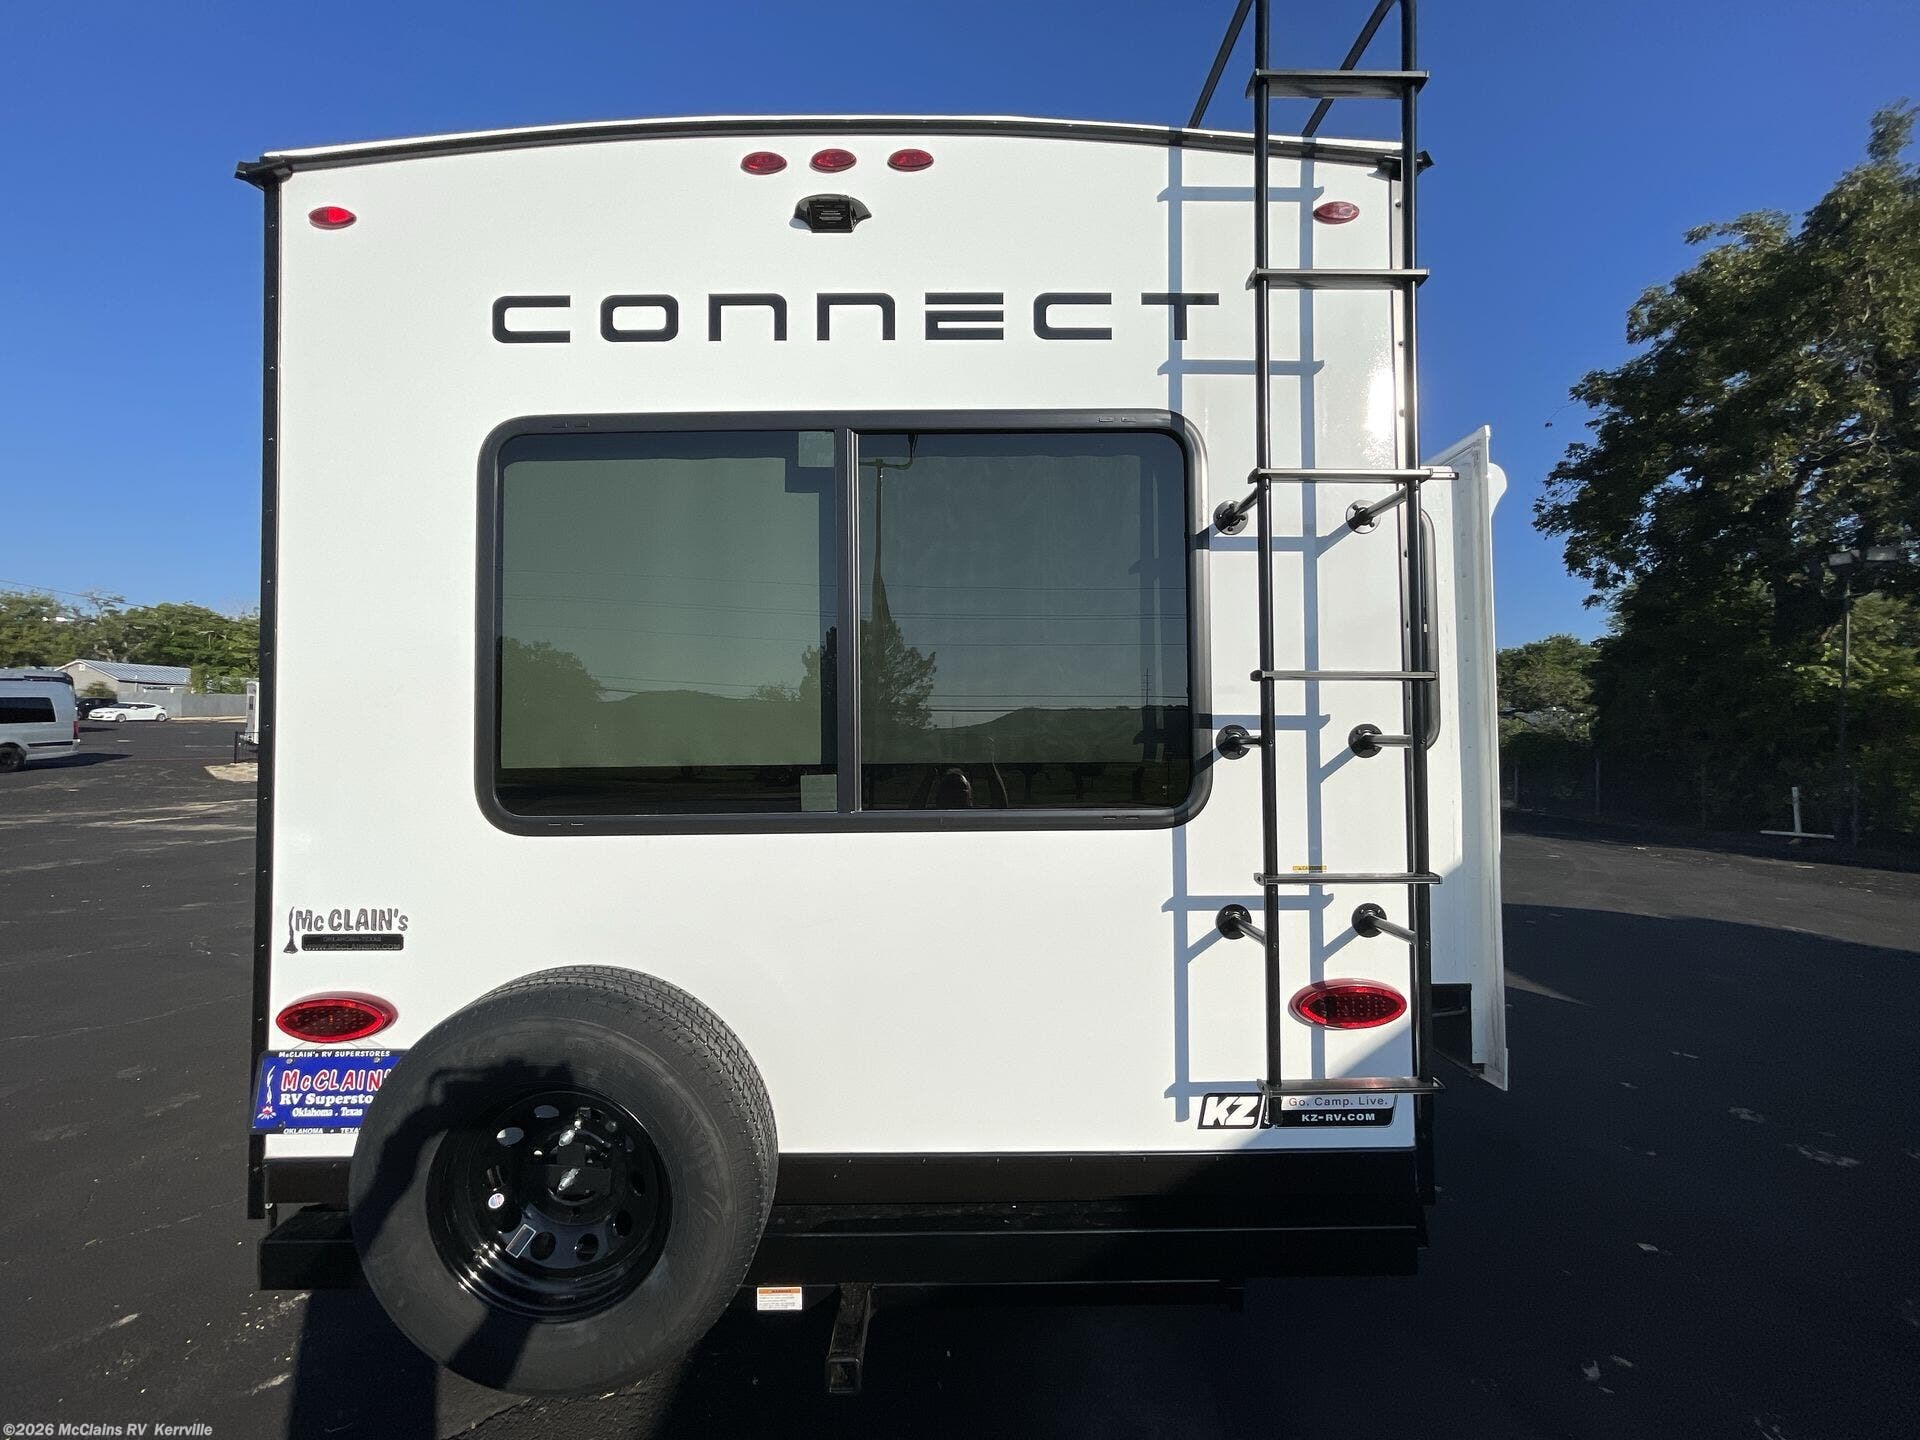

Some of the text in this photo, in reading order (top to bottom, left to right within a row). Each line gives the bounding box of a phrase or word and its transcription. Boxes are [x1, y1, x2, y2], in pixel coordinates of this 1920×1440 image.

[281, 1068, 392, 1092] McCLAIN'
[279, 1093, 374, 1106] RV Supersto
[1288, 1096, 1389, 1108] Go. Camp. Live.
[292, 1107, 363, 1117] Oklahoma Texas
[1202, 1096, 1259, 1126] KZ
[1301, 1113, 1376, 1122] KZ-RV.COM
[283, 1127, 324, 1135] OKLAHOMA
